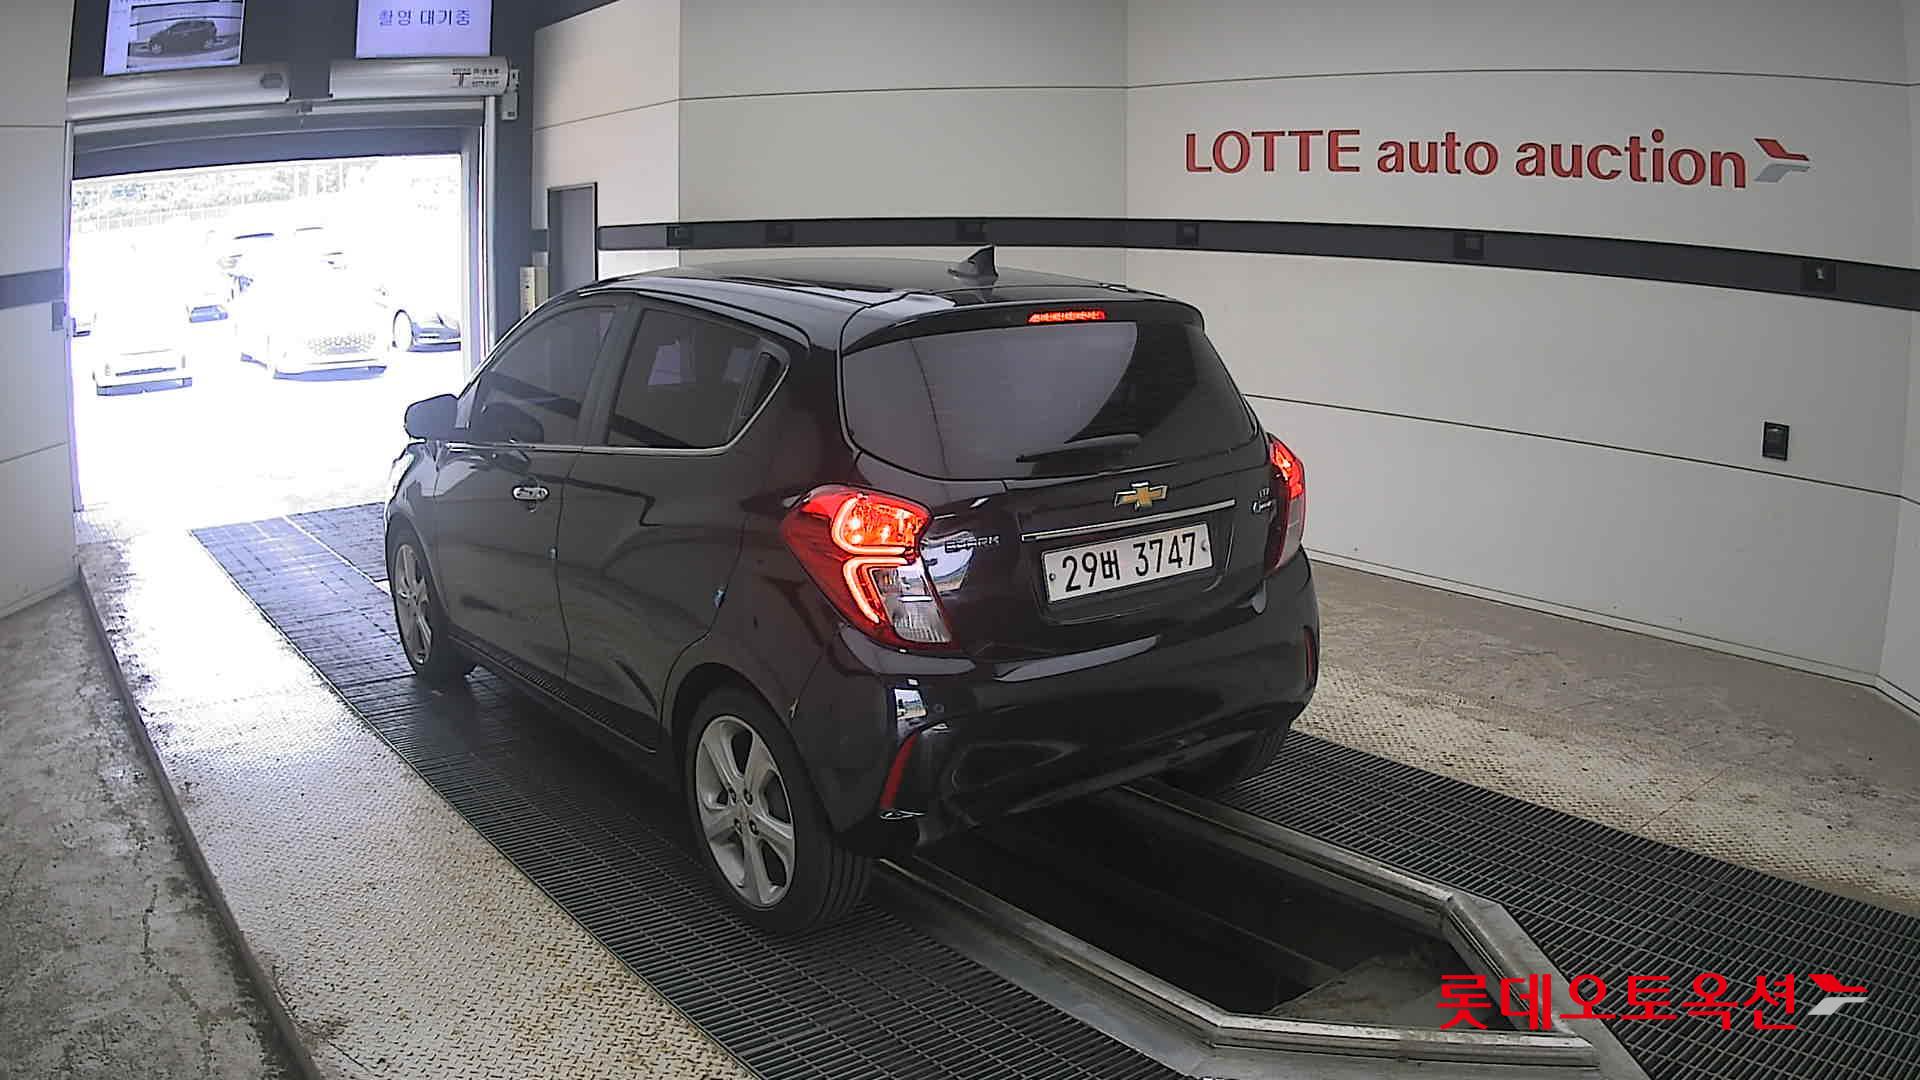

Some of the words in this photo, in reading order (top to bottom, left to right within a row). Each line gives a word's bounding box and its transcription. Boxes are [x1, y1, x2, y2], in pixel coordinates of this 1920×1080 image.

[420, 9, 471, 26] 대기중
[1185, 130, 1361, 174] LOTTE
[1377, 132, 1498, 176] auto
[1515, 129, 1747, 189] auction
[1062, 550, 1120, 593] 29버
[1133, 532, 1195, 577] 3747
